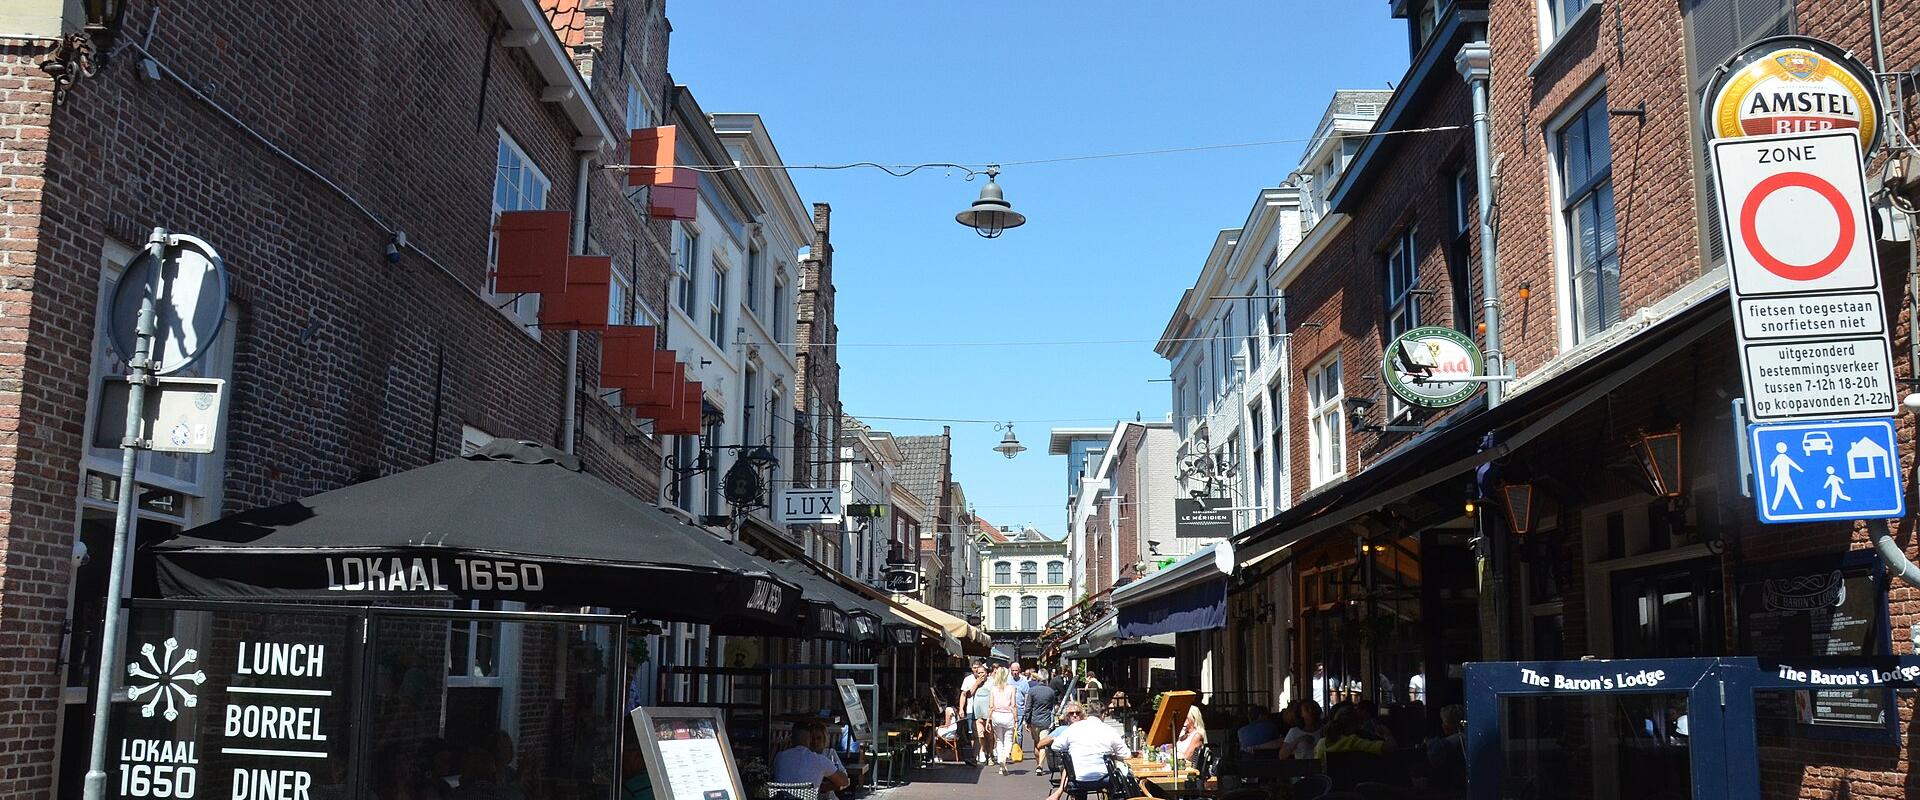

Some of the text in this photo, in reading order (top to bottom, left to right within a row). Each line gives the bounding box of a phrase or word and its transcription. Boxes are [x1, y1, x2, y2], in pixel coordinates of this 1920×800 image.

[1750, 92, 1854, 116] AMSTEL
[1757, 145, 1817, 164] ZONE
[1749, 302, 1873, 317] fietsen toegestaan
[1761, 316, 1866, 332] snorfietsen niet
[1778, 344, 1855, 362] uitgezonderd
[1759, 361, 1880, 378] bestemmingsverkeer
[1764, 376, 1879, 394] tussen 7-12h 18-20h
[1757, 391, 1891, 414] op koopavonden 21-22h
[785, 496, 834, 515] LUX
[325, 557, 545, 592] LOKAAL 1650
[237, 641, 325, 677] LUNCH
[1520, 668, 1666, 690] The Baron's Lodge
[1779, 664, 1920, 686] The Baron's Lodge
[224, 704, 328, 741] BORREL
[120, 738, 199, 764] LOKAAL
[119, 764, 197, 799] 1650
[231, 768, 312, 800] DINER
